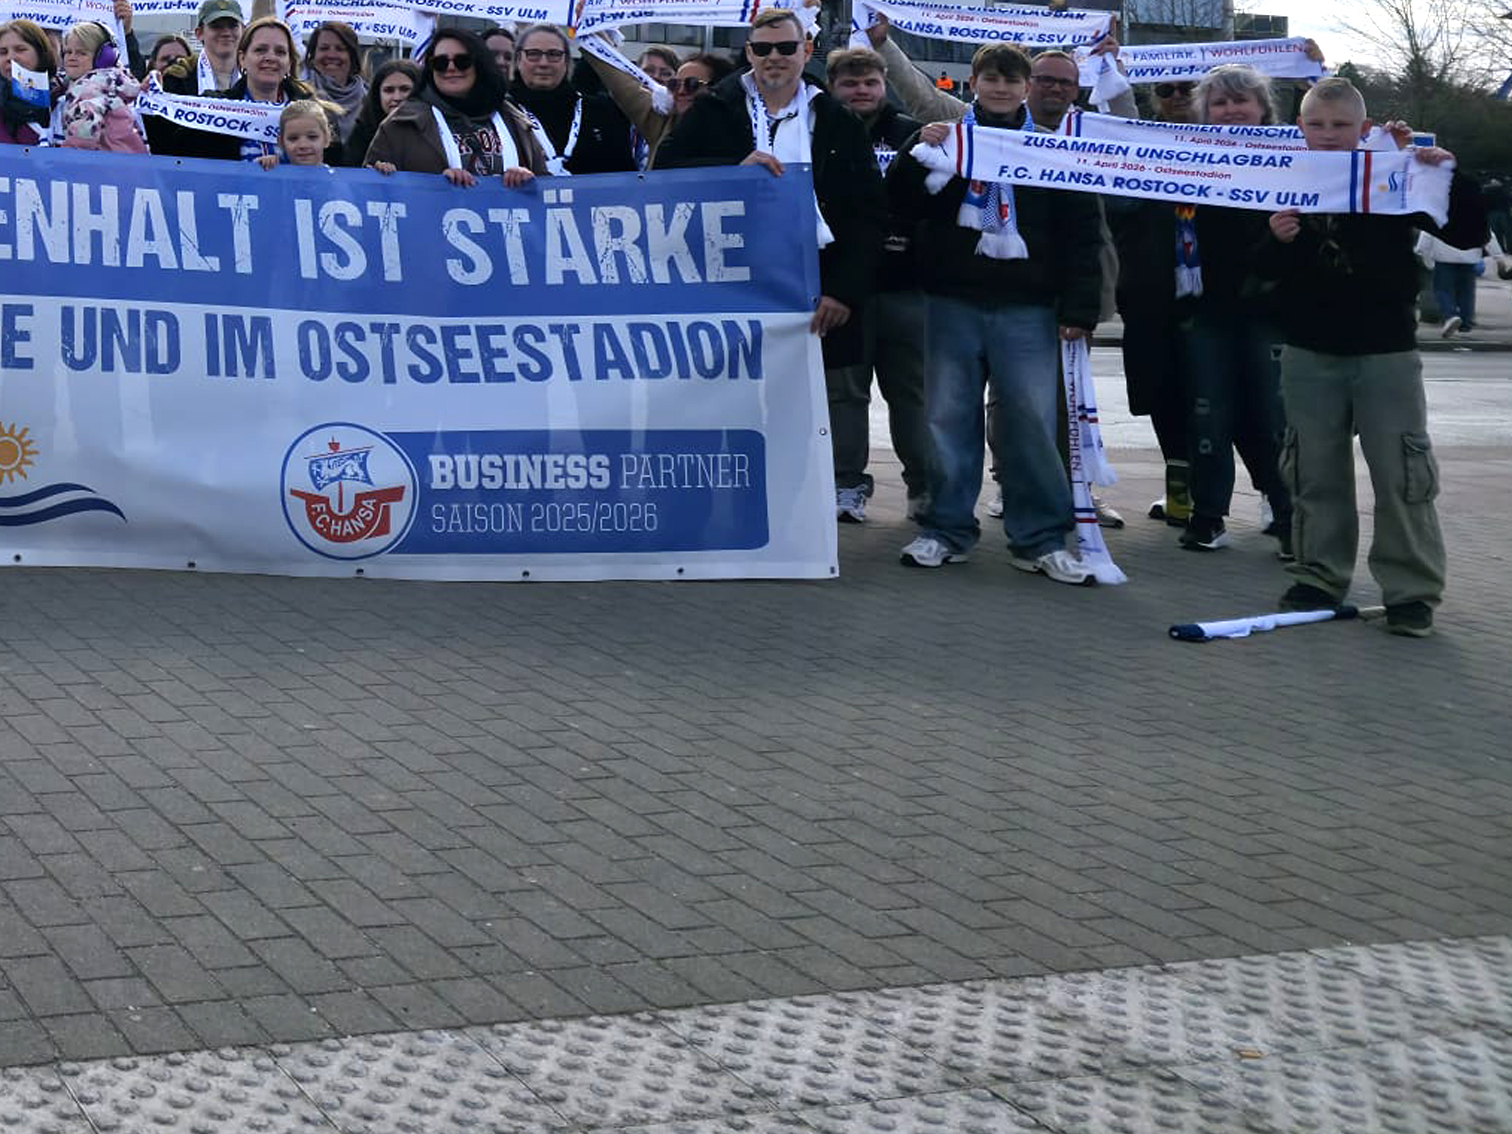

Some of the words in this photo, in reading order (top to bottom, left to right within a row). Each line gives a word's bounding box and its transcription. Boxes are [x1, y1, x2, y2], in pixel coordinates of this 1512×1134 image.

[373, 23, 396, 34] SSV
[486, 5, 514, 17] SSV
[518, 8, 548, 20] ULM
[948, 26, 1024, 43] ROSTOCK
[1036, 33, 1065, 44] SSV
[174, 108, 253, 133] ROSTOCK
[264, 125, 281, 138] SS
[1229, 126, 1306, 139] UNSCHL
[1023, 135, 1130, 156] ZUSAMMEN
[1136, 146, 1293, 168] UNSCHLAGBAR
[998, 165, 1033, 180] F.C.
[1039, 169, 1106, 187] HANSA
[1112, 176, 1212, 198] ROSTOCK
[1229, 188, 1270, 204] SSV
[1275, 192, 1320, 207] ULM
[1093, 159, 1119, 170] April
[1154, 166, 1232, 180] Ostseestadion
[294, 197, 408, 283] IST
[443, 188, 751, 287] STÄRKE
[60, 304, 181, 376] UND
[204, 312, 277, 379] IM
[297, 319, 764, 385] OSTSEESTADION
[427, 453, 611, 491] BUSINESS
[619, 452, 751, 490] PARTNER
[330, 498, 377, 537] HANSA
[431, 502, 524, 534] SAISON
[531, 501, 659, 534] 2025/2026
